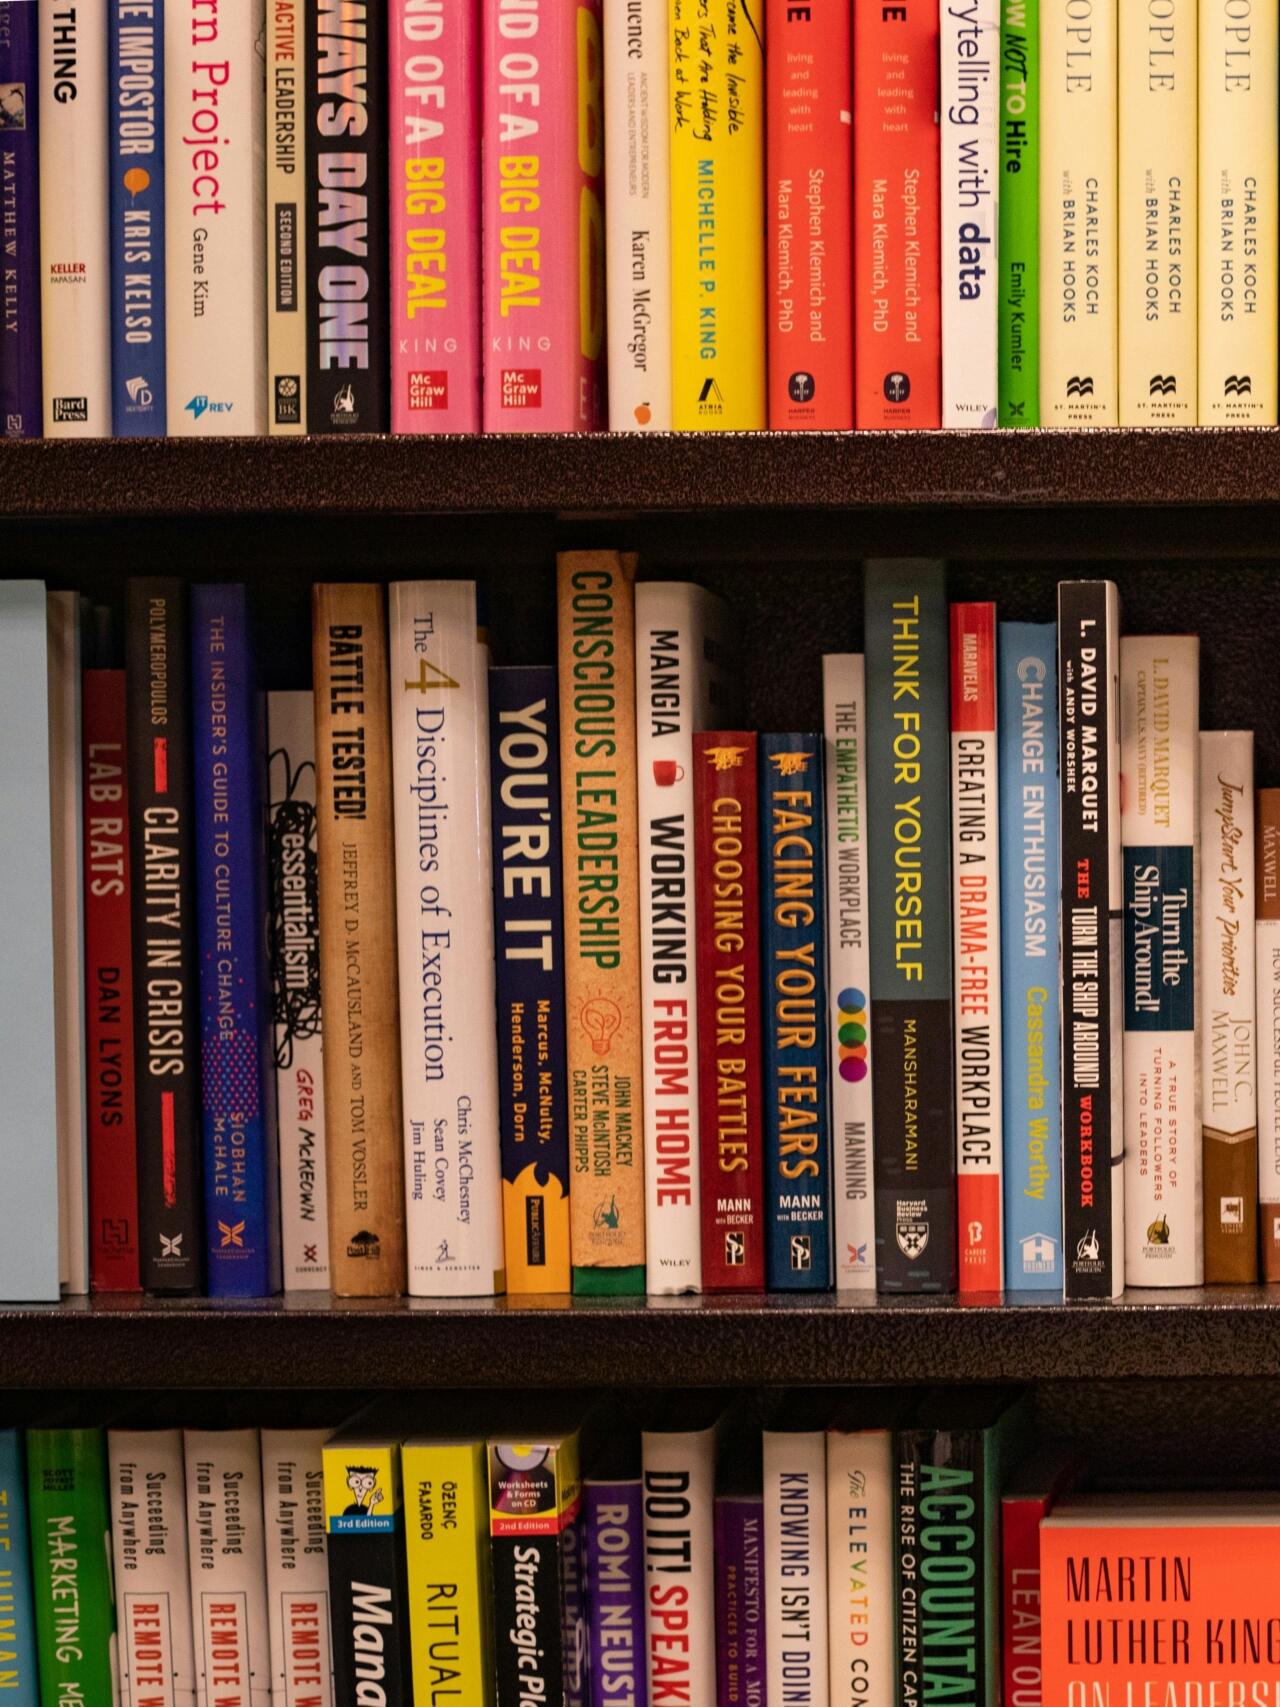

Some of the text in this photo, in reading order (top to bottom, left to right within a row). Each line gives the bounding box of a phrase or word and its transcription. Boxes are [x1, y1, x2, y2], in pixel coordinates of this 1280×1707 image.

[53, 8, 77, 103] THING
[119, 27, 154, 155] IMPOSTOR
[183, 61, 229, 216] Project
[51, 263, 85, 274] KELLER
[124, 211, 152, 343] KRIS KELSO
[193, 228, 208, 317] Gene Kim
[280, 211, 292, 304] SECOND EDITION
[318, 153, 369, 369] DAY ONE
[806, 169, 826, 341] Stephen Klemich and
[959, 140, 991, 300] with data
[1086, 178, 1098, 314] CHARLES KOCH
[627, 231, 650, 372] Karen McGregor
[150, 599, 167, 725] POLYMEROPOULOS
[329, 625, 366, 820] BATTLE TESTED!
[650, 631, 680, 737] MANGIA
[90, 744, 124, 896] LAB RATS
[210, 617, 235, 1042] THE INSIDER'S GUIDE TO CULTURE CHANGE
[500, 699, 552, 970] YOU'RE IT
[571, 570, 620, 969] CONSCIOUS LEADERSHIP
[893, 596, 922, 981] THINK FOR YOURSELF
[144, 807, 184, 1075] CLARITY IN CRISIS
[279, 827, 320, 988] essentialism
[410, 707, 453, 1081] Disciplines of Execution
[512, 1003, 527, 1142] Henderson, Dorn
[651, 814, 690, 1206] WORKING FROM HOME
[296, 1069, 313, 1121] GREG
[433, 1119, 448, 1202] Sean Covey
[904, 1020, 917, 1170] MANSHARAMANI
[1024, 987, 1050, 1200] Cassandra Worthy
[1080, 1095, 1093, 1207] WORKBOOK
[120, 1463, 141, 1571] from Anywhere
[145, 1472, 168, 1555] Succeeding
[338, 1518, 390, 1530] 3rd Edition
[597, 1504, 631, 1592] ROMI
[780, 1473, 810, 1641] KNOWING ISN'T
[849, 1508, 868, 1646] ELEVATED
[1067, 1557, 1190, 1601] MARTIN
[133, 1604, 163, 1687] REMOTE
[510, 1545, 541, 1671] Strategic
[1068, 1620, 1189, 1664] LUTHER
